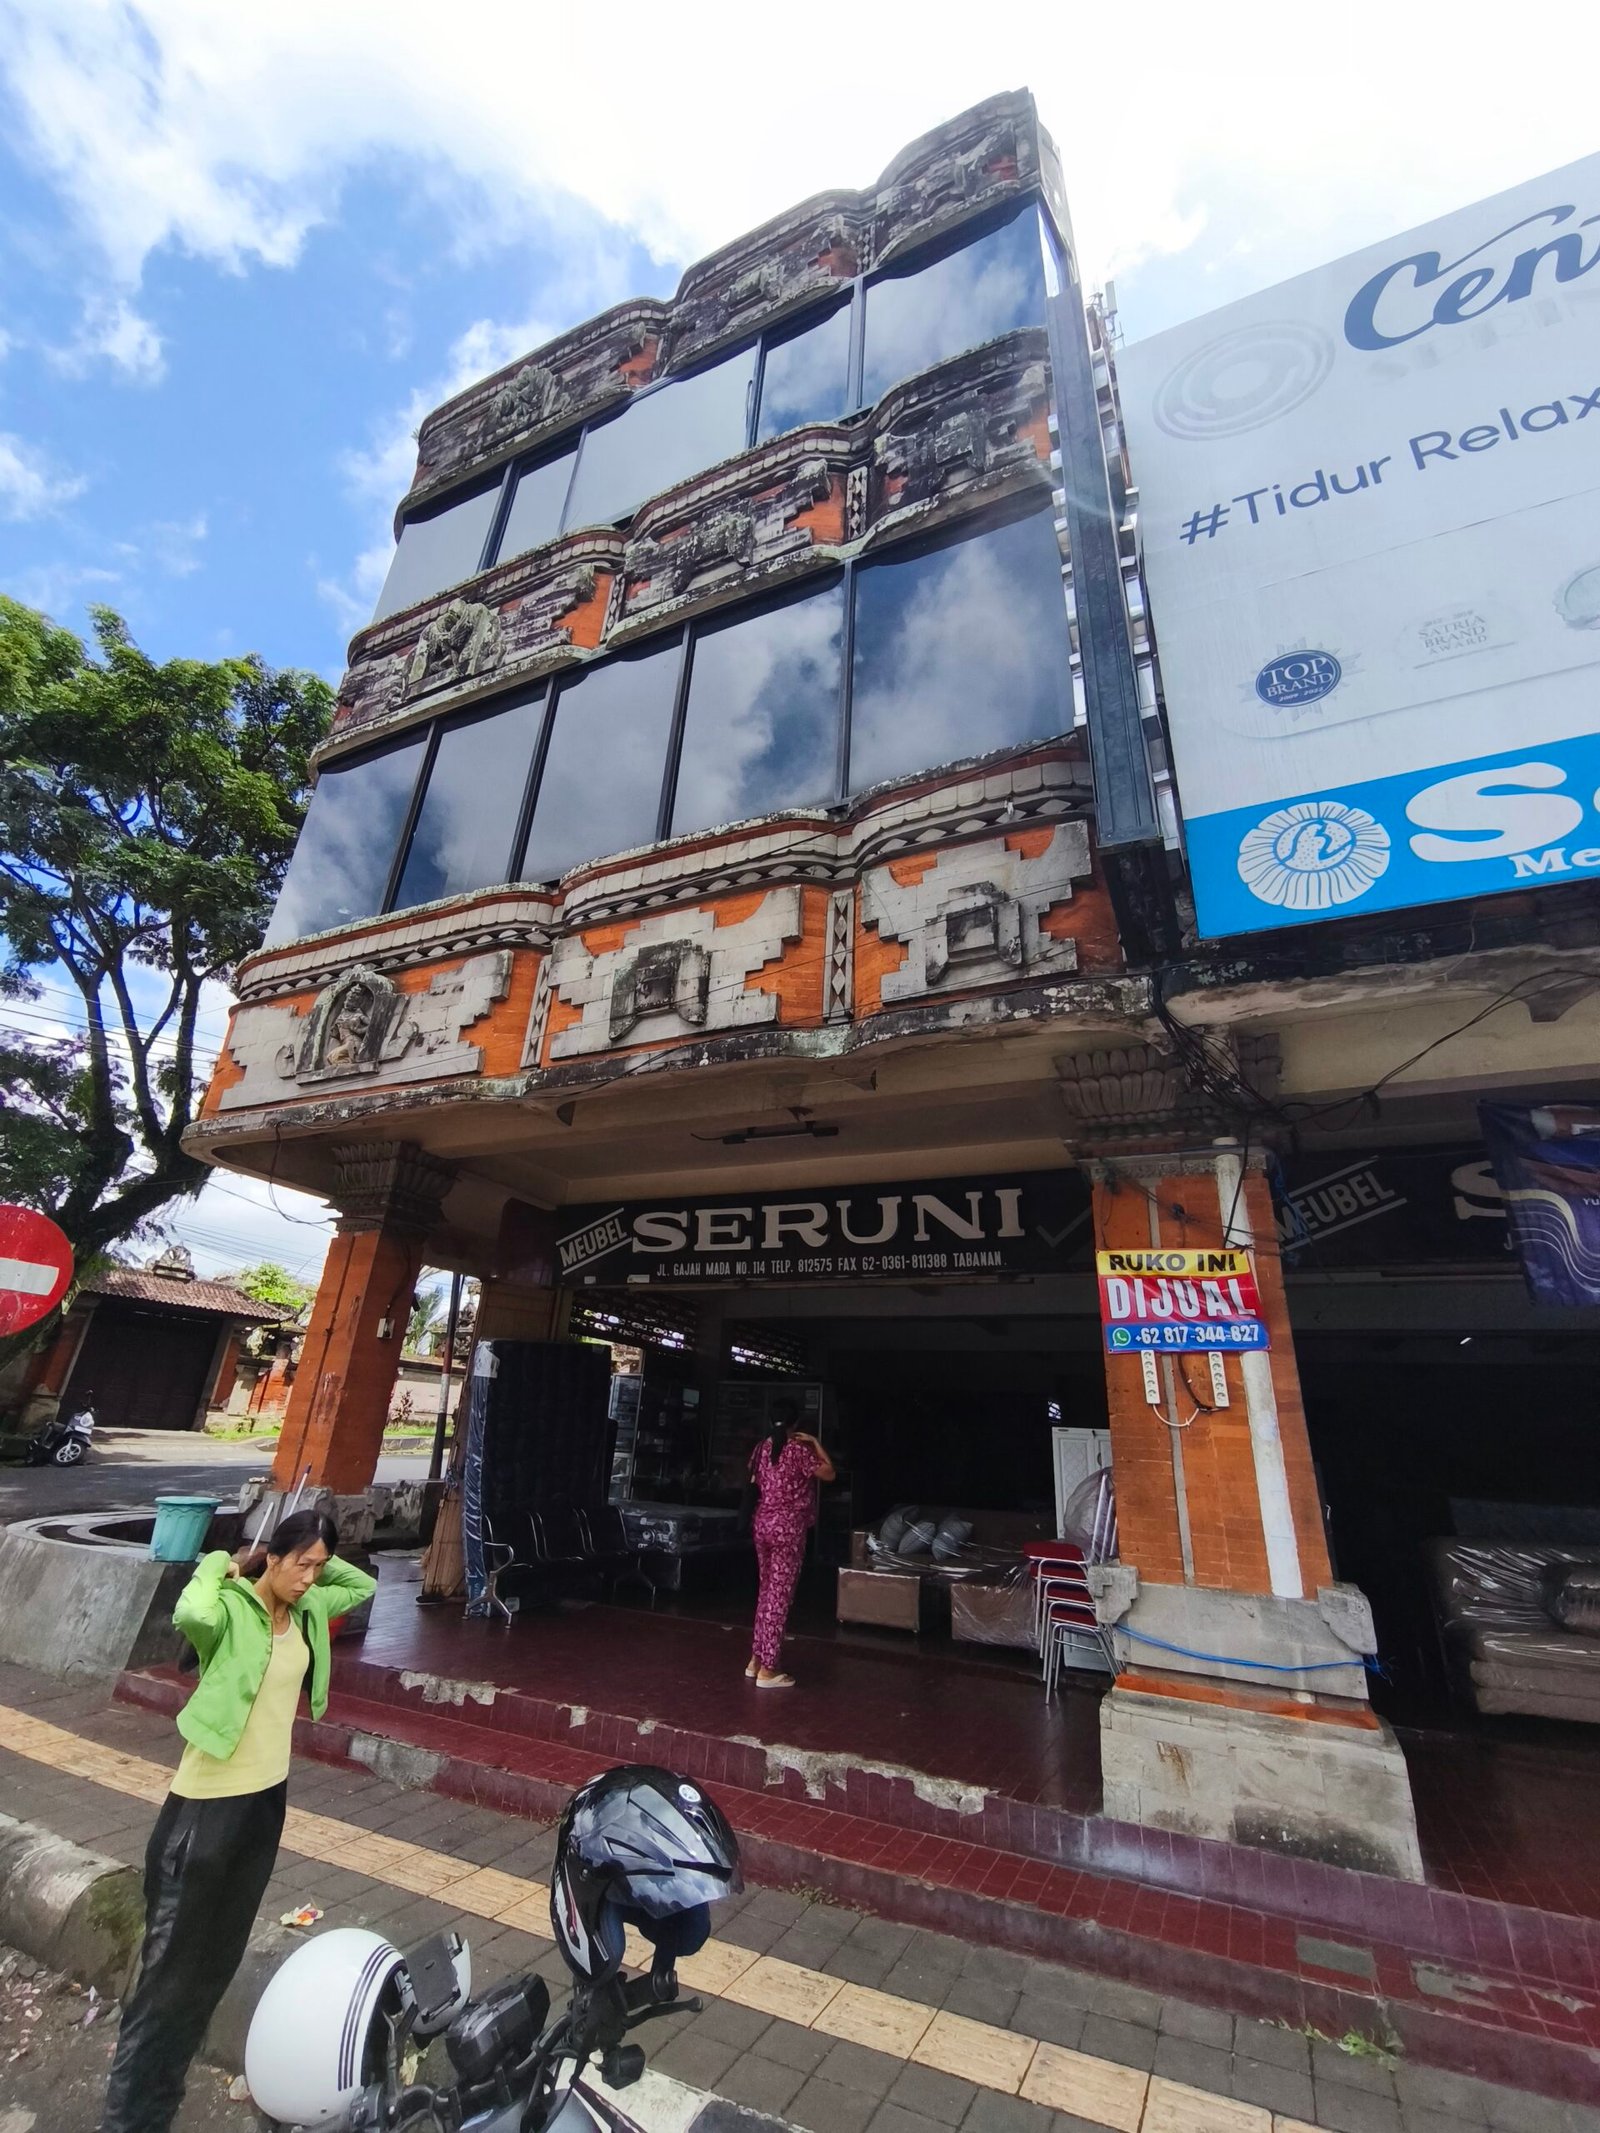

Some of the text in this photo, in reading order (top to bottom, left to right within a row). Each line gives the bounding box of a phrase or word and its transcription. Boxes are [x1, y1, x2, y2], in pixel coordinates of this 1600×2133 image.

[1343, 204, 1600, 351] Cen
[1179, 386, 1600, 545] #Tidur Relax
[1424, 626, 1485, 648] BRAND
[1262, 657, 1328, 686] TOP
[1266, 672, 1333, 697] BRAND
[1405, 761, 1600, 862] S
[632, 1188, 1026, 1253] SERUNI
[560, 1217, 627, 1267] MEUBEL
[656, 1263, 670, 1277] JL.
[673, 1262, 701, 1276] GAJAH
[705, 1261, 731, 1275] MADA
[771, 1259, 794, 1274] TELP.
[798, 1257, 833, 1273] 812575
[837, 1257, 857, 1272] FAX
[862, 1253, 947, 1271] 62-0361-811388
[1108, 1253, 1237, 1272] RUKO INI
[1106, 1278, 1257, 1319] DIJUAL
[1135, 1327, 1161, 1344] +62
